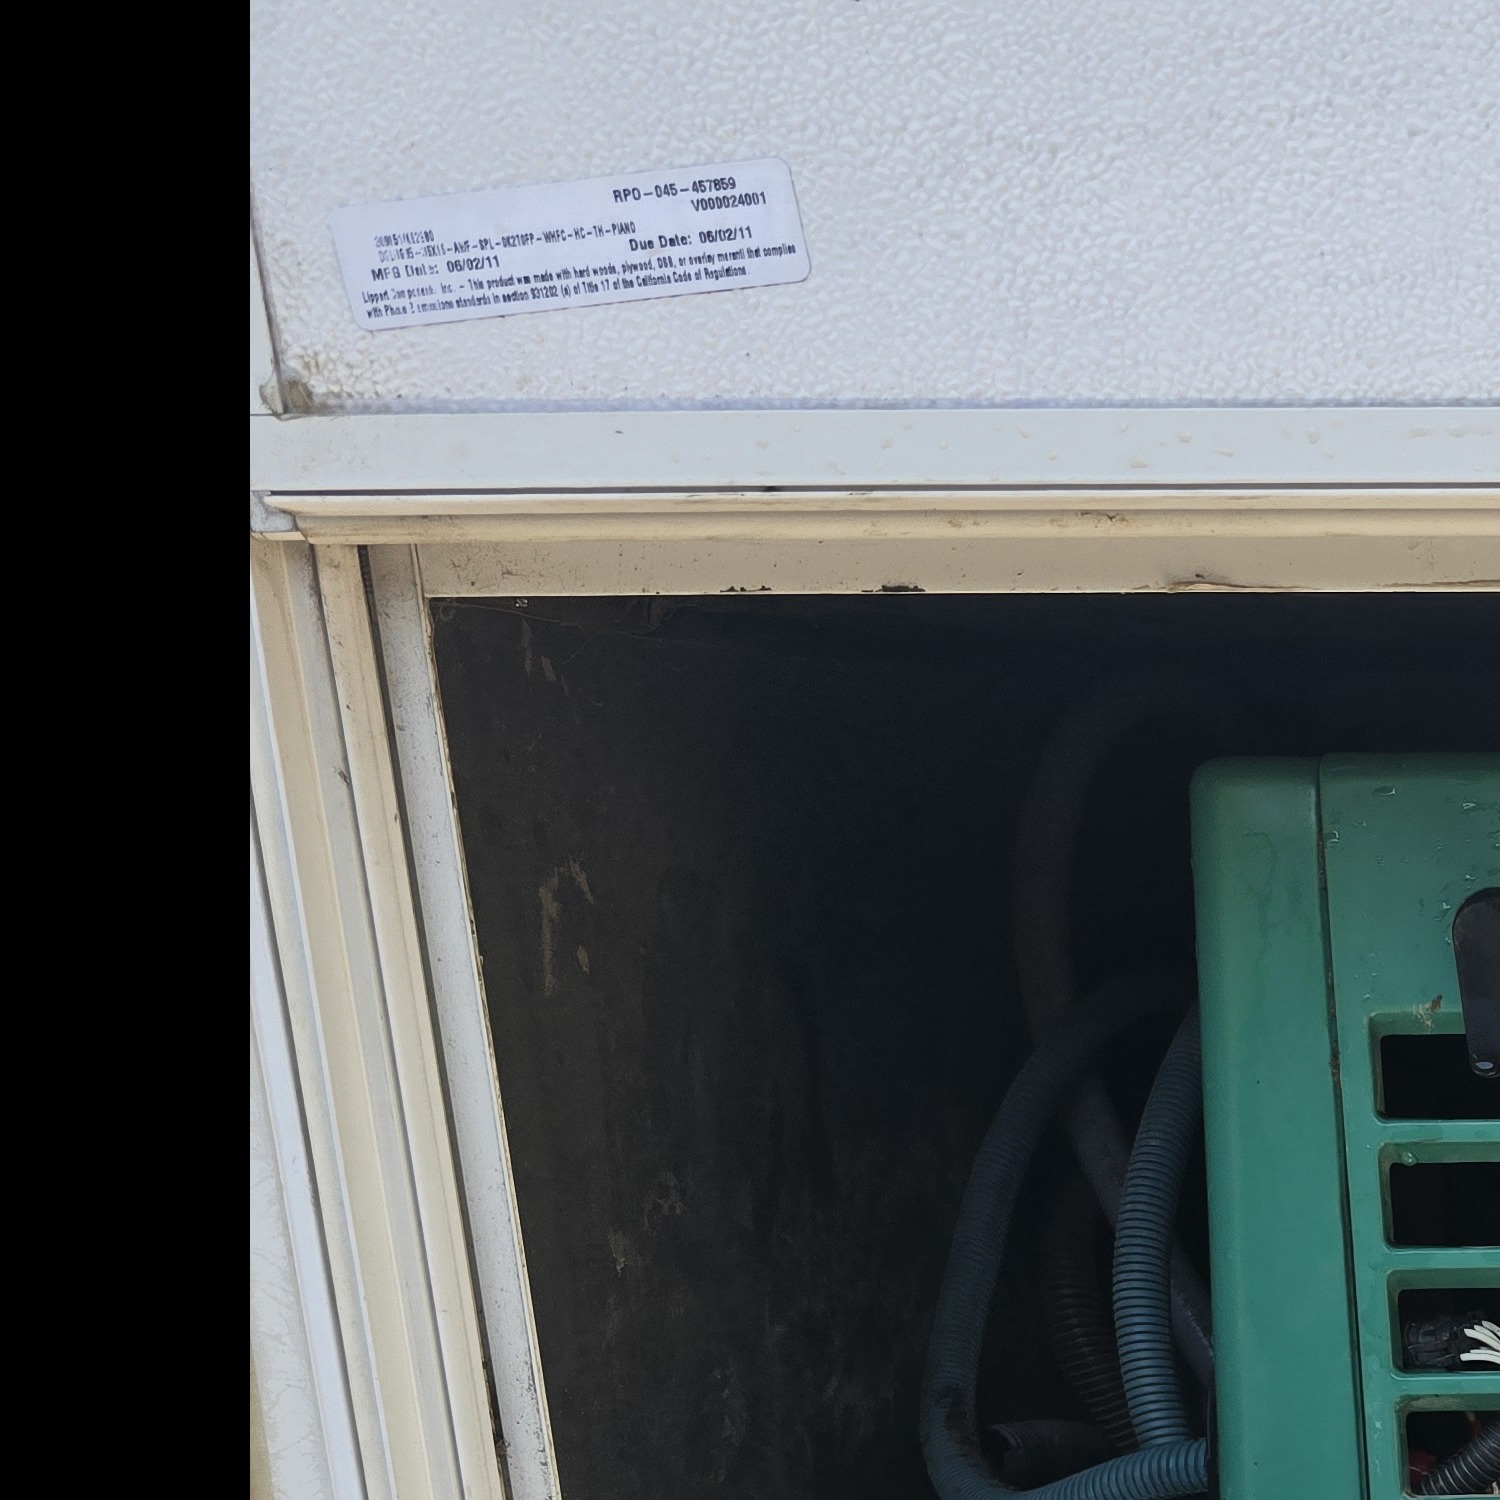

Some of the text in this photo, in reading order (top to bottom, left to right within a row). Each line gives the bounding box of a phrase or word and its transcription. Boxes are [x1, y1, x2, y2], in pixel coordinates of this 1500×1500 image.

[691, 192, 767, 212] V000024001
[629, 225, 753, 252] Due Date: 06/02/11
[446, 255, 500, 273] 06/02/11
